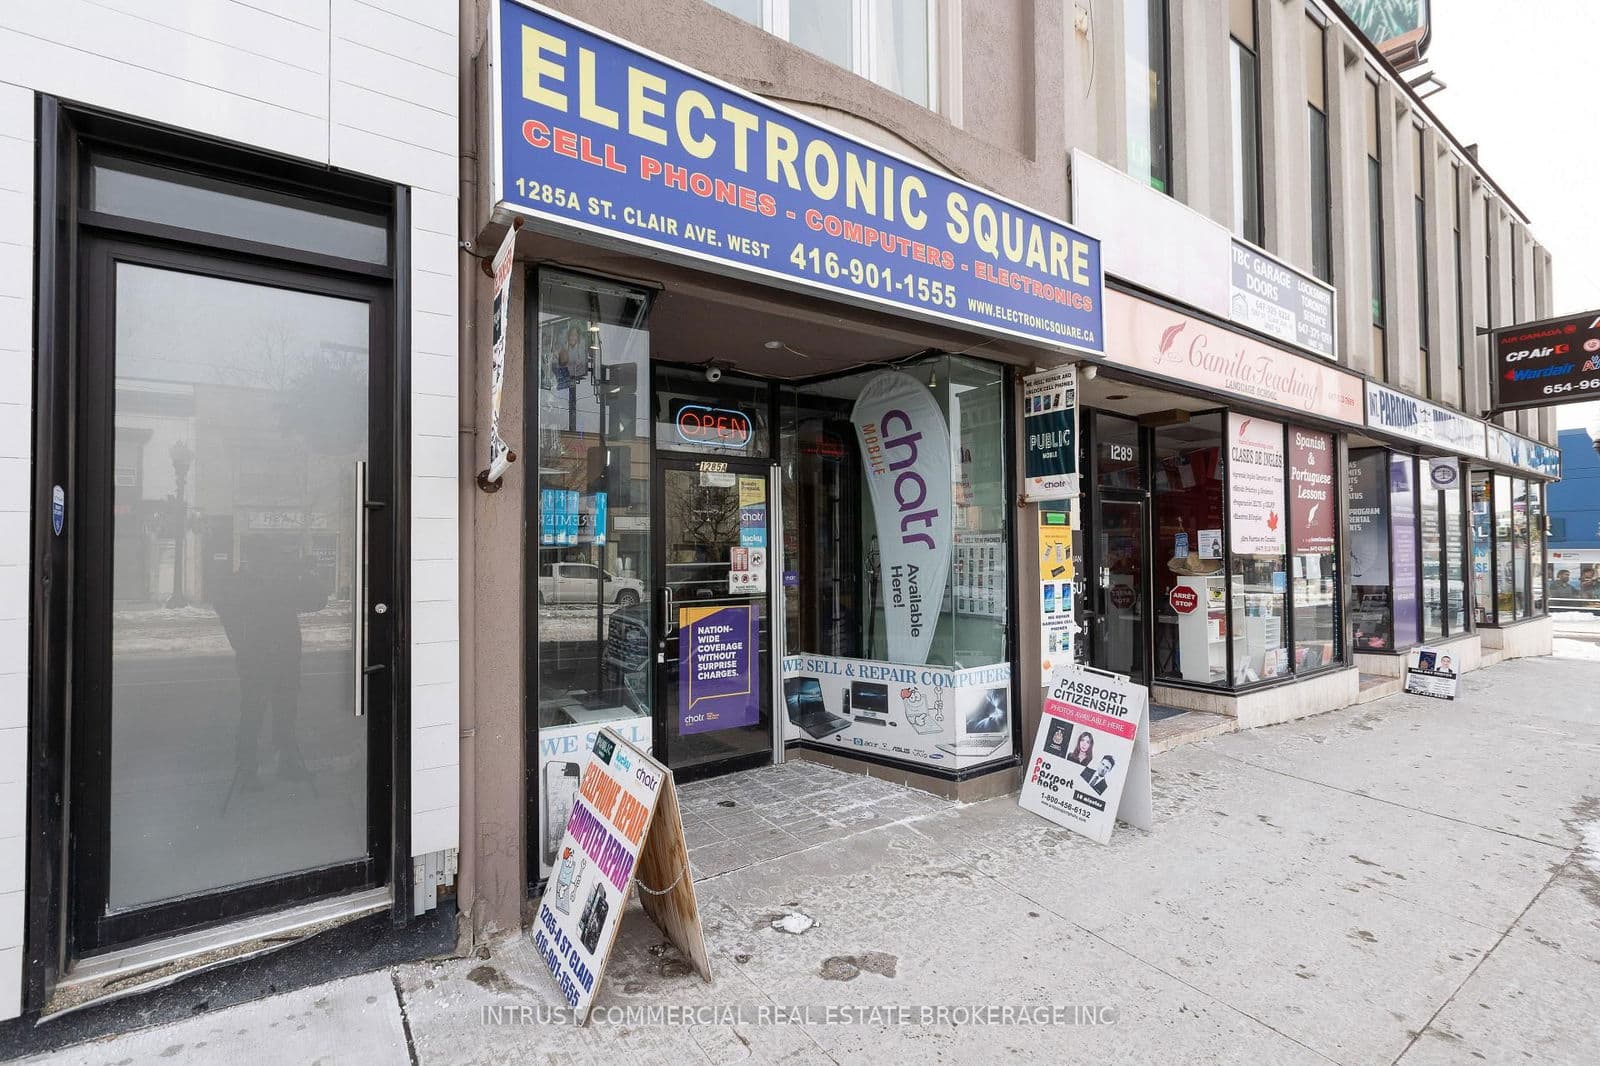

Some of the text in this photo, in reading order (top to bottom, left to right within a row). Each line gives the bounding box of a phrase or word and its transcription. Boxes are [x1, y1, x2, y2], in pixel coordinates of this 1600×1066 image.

[521, 24, 1090, 287] ELECTRONIC SQUARE
[515, 177, 770, 259] 1285A ST. CLAIR AVE. WEST
[521, 119, 627, 174] CELL
[640, 155, 777, 217] PHONES
[805, 208, 955, 271] COMPUTERS
[974, 260, 1093, 312] ELECTRONICS
[790, 242, 957, 309] 416-901-1555
[1232, 246, 1292, 289] TBC GARAGE
[1246, 273, 1279, 301] DOORS
[1297, 280, 1330, 305] LOCKSMITH
[967, 297, 1095, 343] WWW.ELECTRONICSQUARE.CA
[1188, 334, 1319, 411] Camila Teaching
[1224, 379, 1278, 401] LANGUAGE SCHOOL
[1379, 389, 1418, 428] PARDONS
[680, 412, 747, 441] OPEN
[861, 423, 886, 475] MOBILE
[1030, 429, 1071, 451] PUBLIC
[1110, 444, 1133, 461] 1289
[1295, 431, 1326, 451] Spanish
[1231, 446, 1254, 465] CLASES
[1254, 450, 1262, 466] DE
[1307, 451, 1315, 466] &
[881, 409, 940, 551] chatr
[1291, 466, 1331, 486] Portuguese
[1297, 484, 1327, 501] Lessons
[741, 513, 764, 522] chatr
[890, 564, 906, 609] Here!
[906, 563, 923, 639] Available
[1174, 600, 1193, 608] STOP
[698, 624, 734, 635] NATION-
[698, 635, 720, 644] WIDE
[697, 642, 743, 653] COVERAGE
[697, 651, 737, 662] WITHOUT
[697, 660, 737, 671] SURPRISE
[697, 669, 739, 680] CHARGES.
[782, 658, 1010, 689] WE SELL & REPAIR COMPUTERS
[1053, 688, 1128, 718] CITIZENSHIP
[1060, 678, 1127, 705] PASSPORT
[684, 713, 705, 723] chatr
[1051, 704, 1125, 731] PHOTOS AVAILABLE HERE
[540, 735, 579, 757] WE
[1036, 757, 1052, 770] Pro
[635, 768, 658, 792] chatr
[1031, 774, 1059, 793] Photo
[1033, 765, 1074, 790] Passport
[579, 761, 649, 847] CELLPHONE REPAIR
[566, 799, 634, 894] COMPUTER REPAIR
[540, 903, 594, 994] 1285-A ST CLAIR
[535, 929, 580, 1008] 416-901-1555
